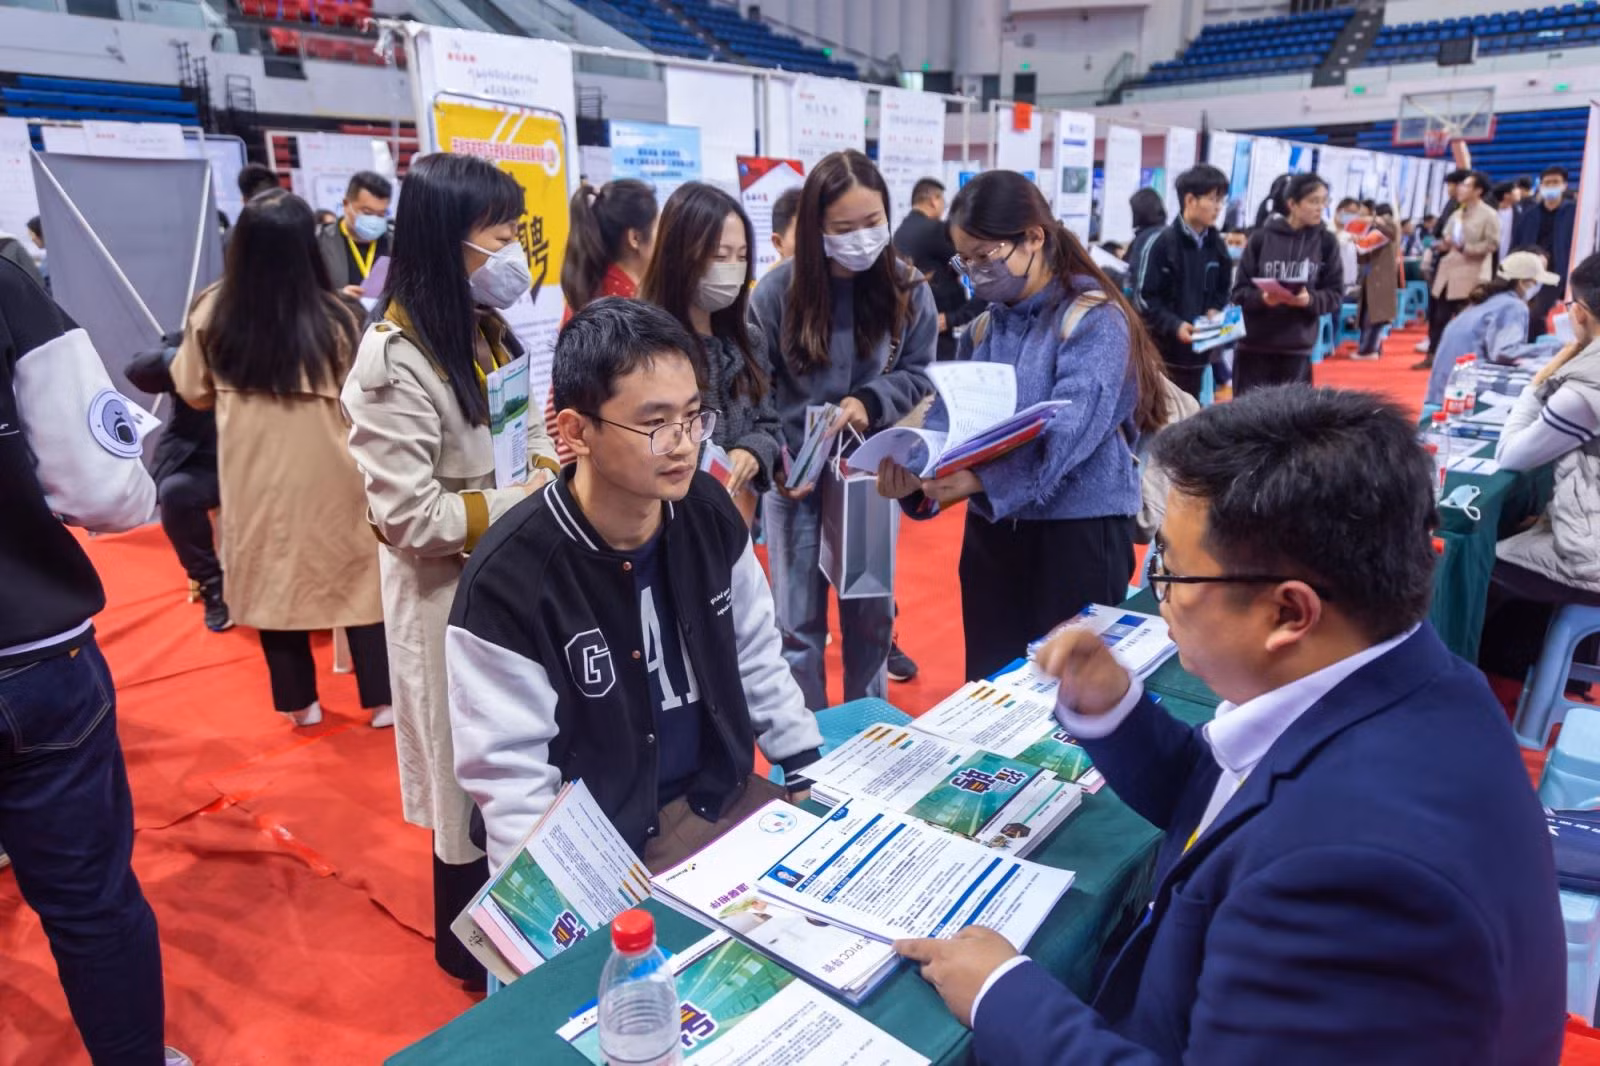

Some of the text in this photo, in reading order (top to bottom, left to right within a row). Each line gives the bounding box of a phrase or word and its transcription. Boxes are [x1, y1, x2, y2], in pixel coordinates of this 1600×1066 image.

[564, 628, 616, 698] G
[949, 767, 1027, 794] 招聘
[710, 882, 750, 910] 温馨相伴
